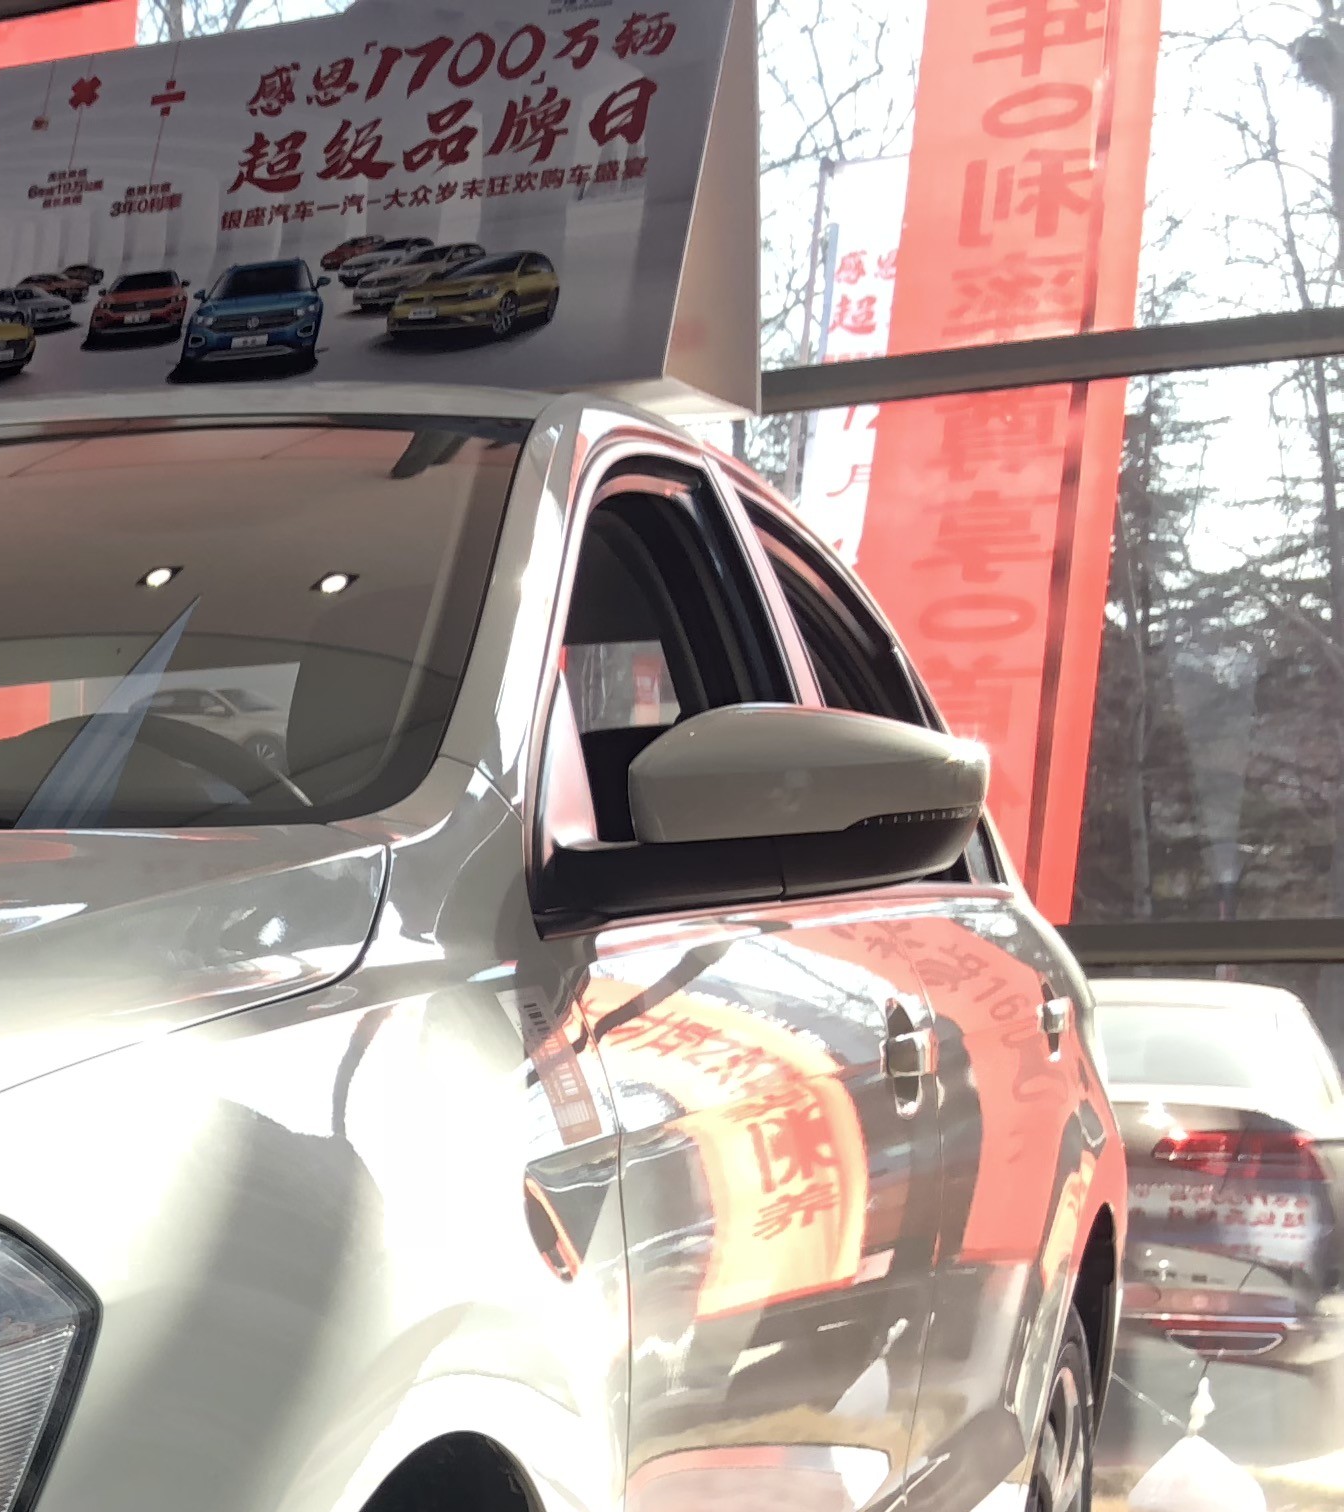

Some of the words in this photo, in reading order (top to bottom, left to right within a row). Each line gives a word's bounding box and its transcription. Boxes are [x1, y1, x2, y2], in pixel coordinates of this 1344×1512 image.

[227, 77, 658, 194] 超级品牌日
